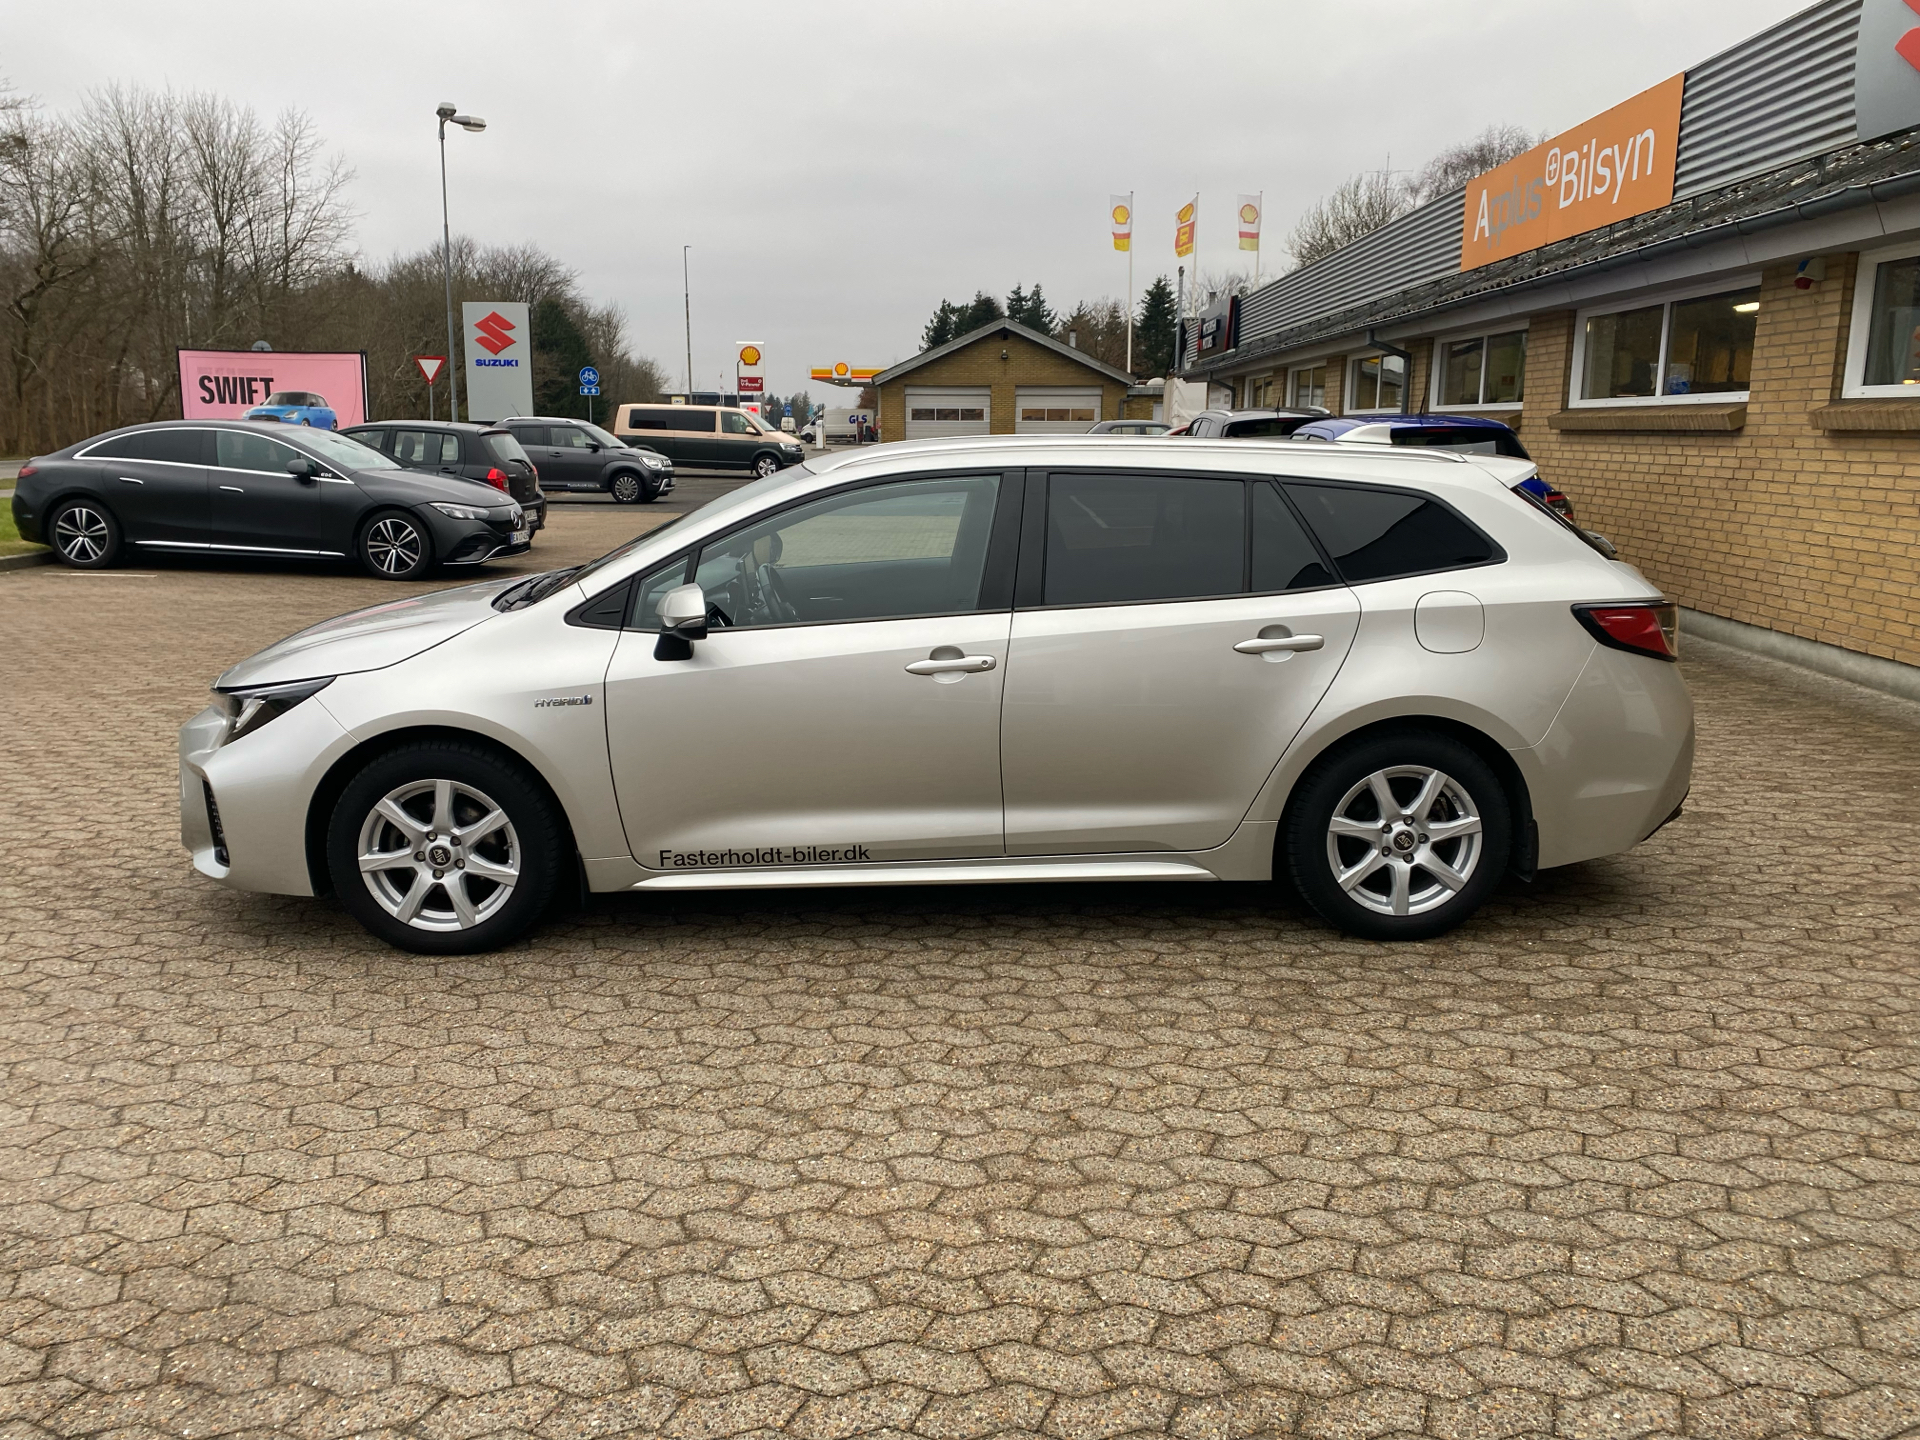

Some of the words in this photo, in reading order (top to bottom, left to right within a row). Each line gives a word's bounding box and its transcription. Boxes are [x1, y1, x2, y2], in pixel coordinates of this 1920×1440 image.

[1558, 128, 1655, 210] Bilsyn
[475, 358, 519, 367] SUZUKI
[198, 375, 275, 405] SWIFT
[534, 696, 583, 708] HYBRID
[659, 845, 871, 867] Fasterholdt-biler.dk
